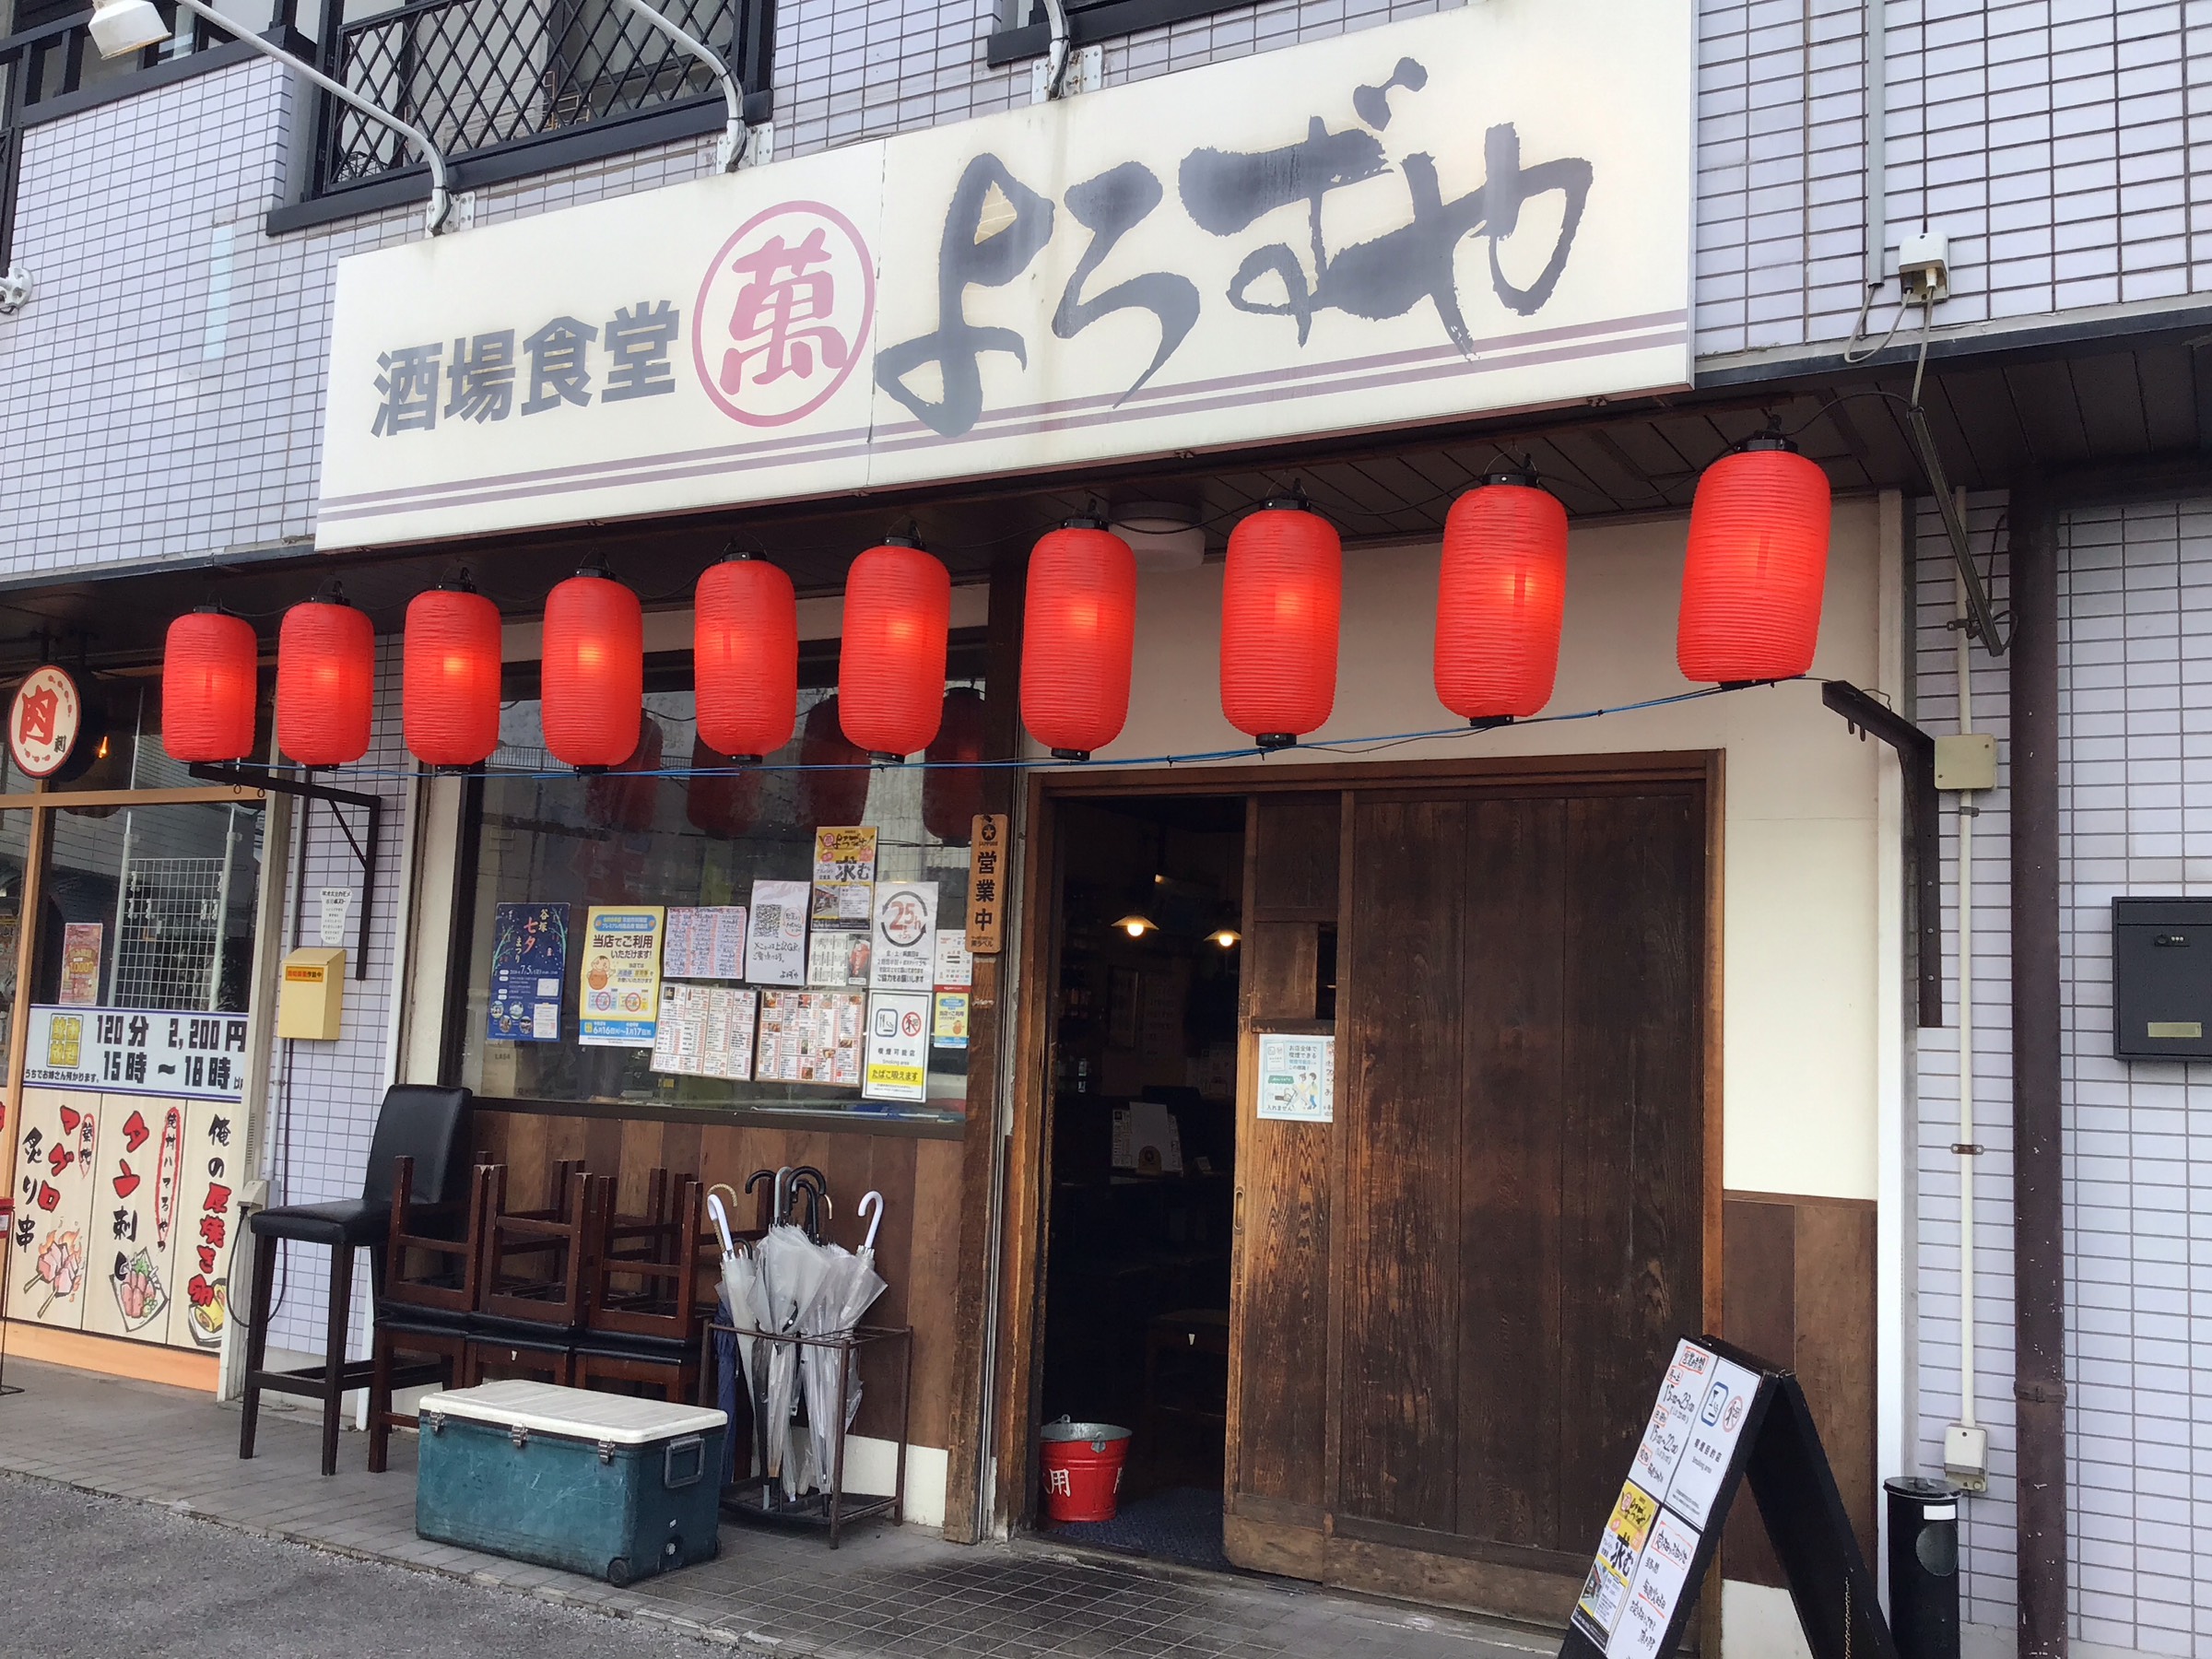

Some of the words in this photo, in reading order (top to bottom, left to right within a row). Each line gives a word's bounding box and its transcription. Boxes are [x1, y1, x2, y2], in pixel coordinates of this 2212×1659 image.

[876, 56, 1594, 438] よろずや
[370, 300, 680, 438] 酒場食堂
[19, 685, 59, 746] 肉
[974, 850, 997, 932] 営業中
[524, 916, 538, 955] 七夕
[538, 909, 549, 933] 谷塚
[514, 935, 523, 963] まつり
[593, 934, 653, 949] 当店でご利用
[610, 949, 653, 959] いただけます!
[97, 1015, 149, 1048] 120分
[168, 1018, 248, 1053] 2,200円
[877, 1047, 916, 1057] 喫煙可能店
[872, 1069, 919, 1081] たばこ吸えます
[38, 1105, 81, 1213] マグロ
[16, 1127, 43, 1253] 炙り串
[112, 1111, 149, 1282] タン刺し
[157, 1112, 177, 1253] 絶対ハマるやつ
[1049, 1467, 1071, 1498] 用
